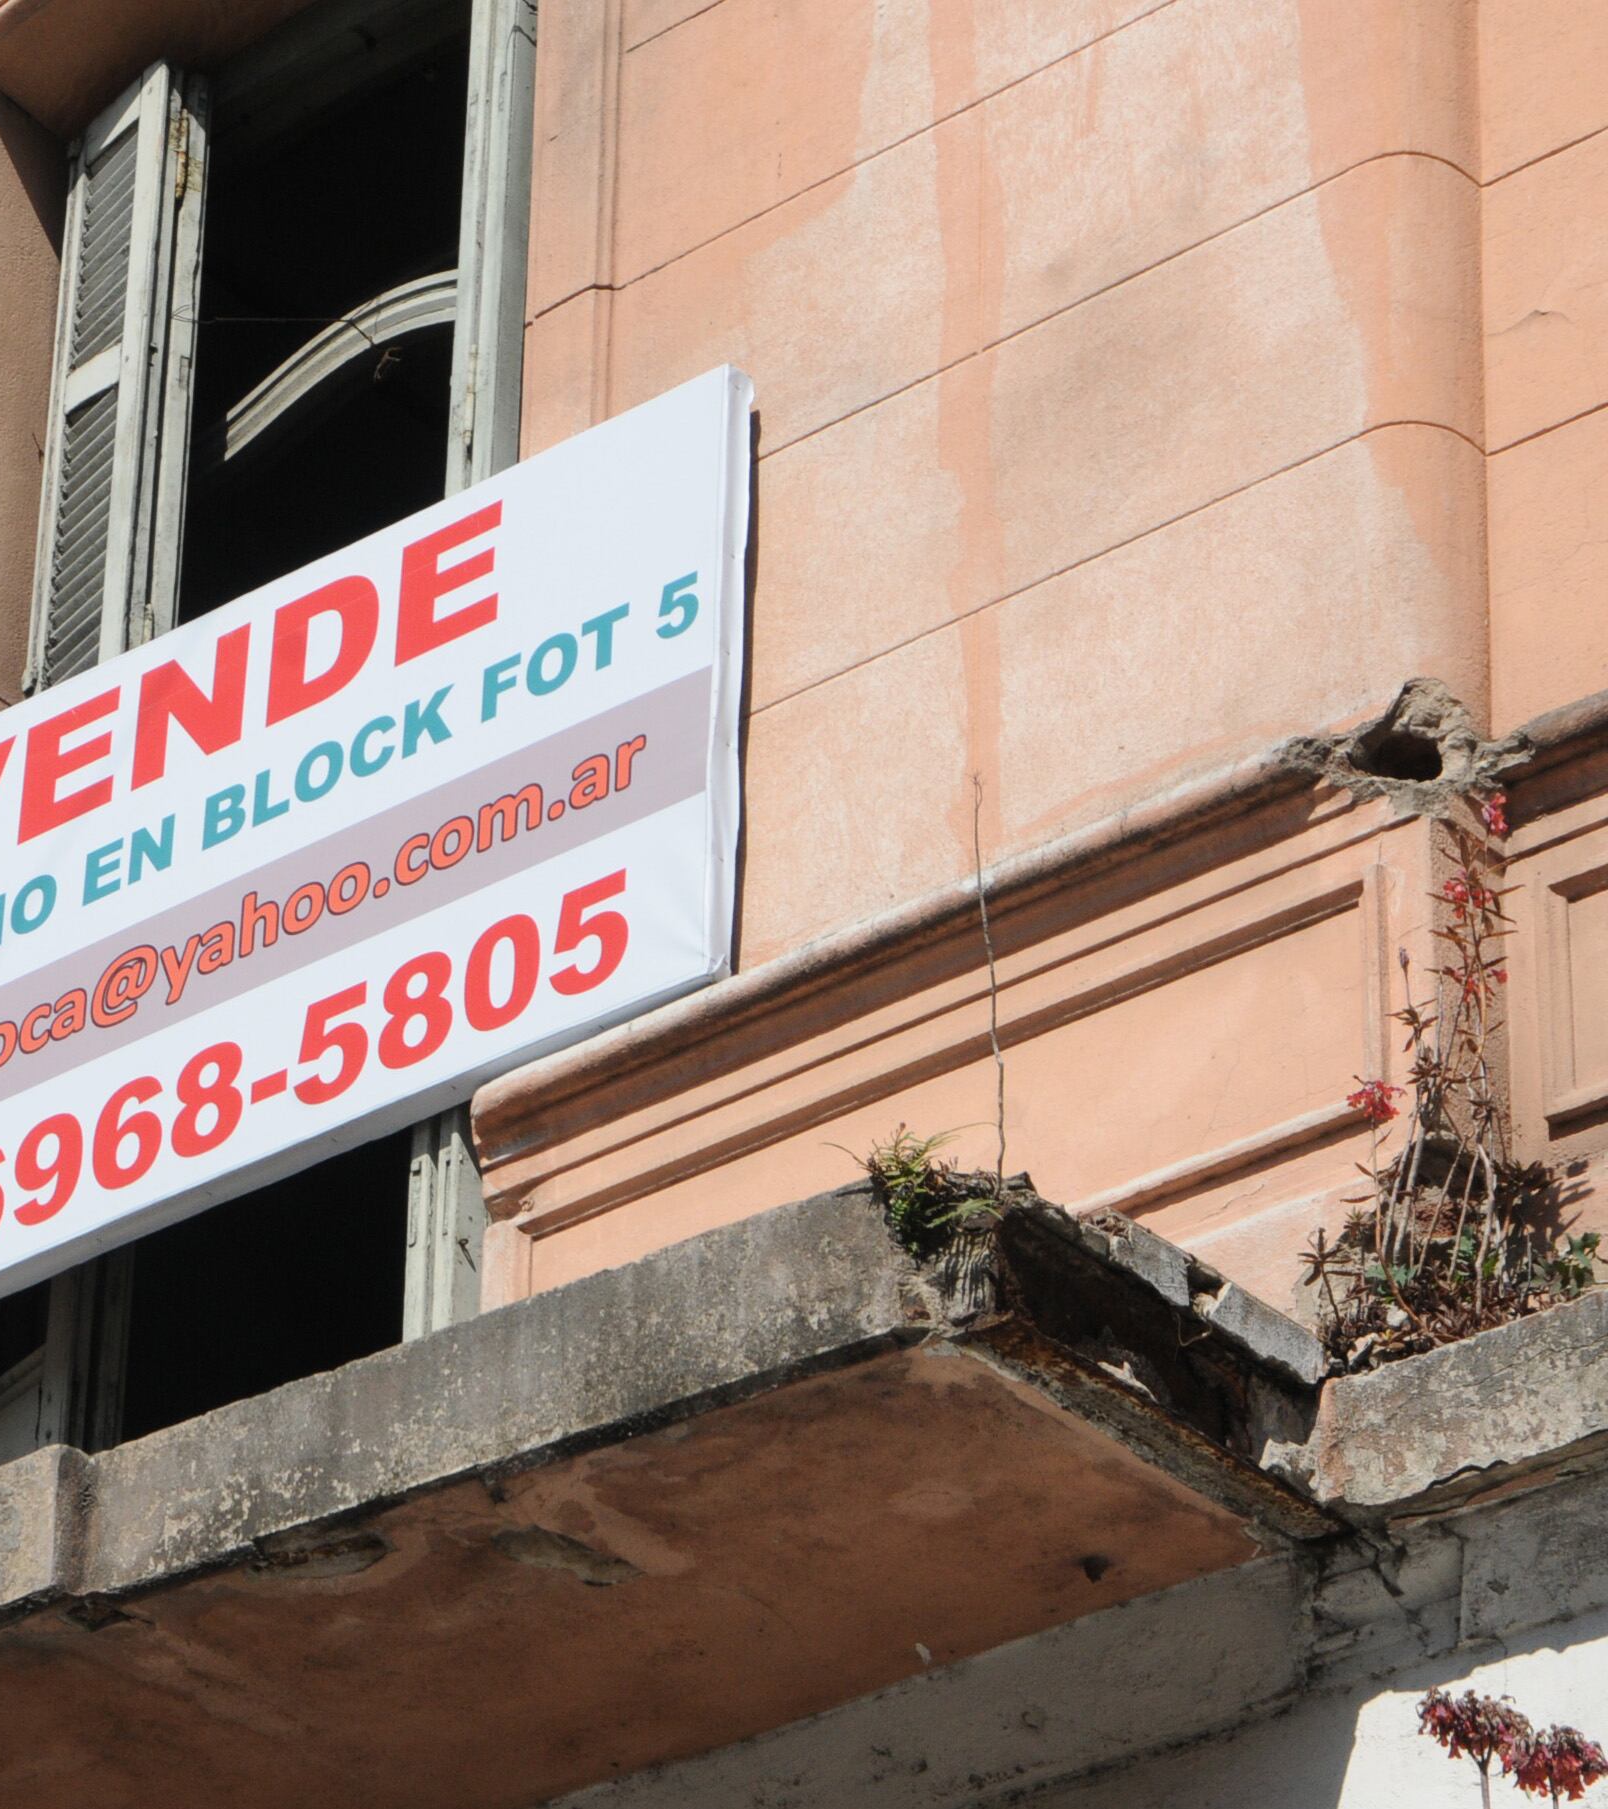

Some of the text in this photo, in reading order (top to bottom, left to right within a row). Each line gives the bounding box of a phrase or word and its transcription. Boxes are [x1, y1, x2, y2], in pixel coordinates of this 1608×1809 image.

[83, 815, 175, 905] EN
[202, 686, 452, 849] BLOCK
[481, 603, 629, 721] FOT
[657, 572, 699, 638] 5
